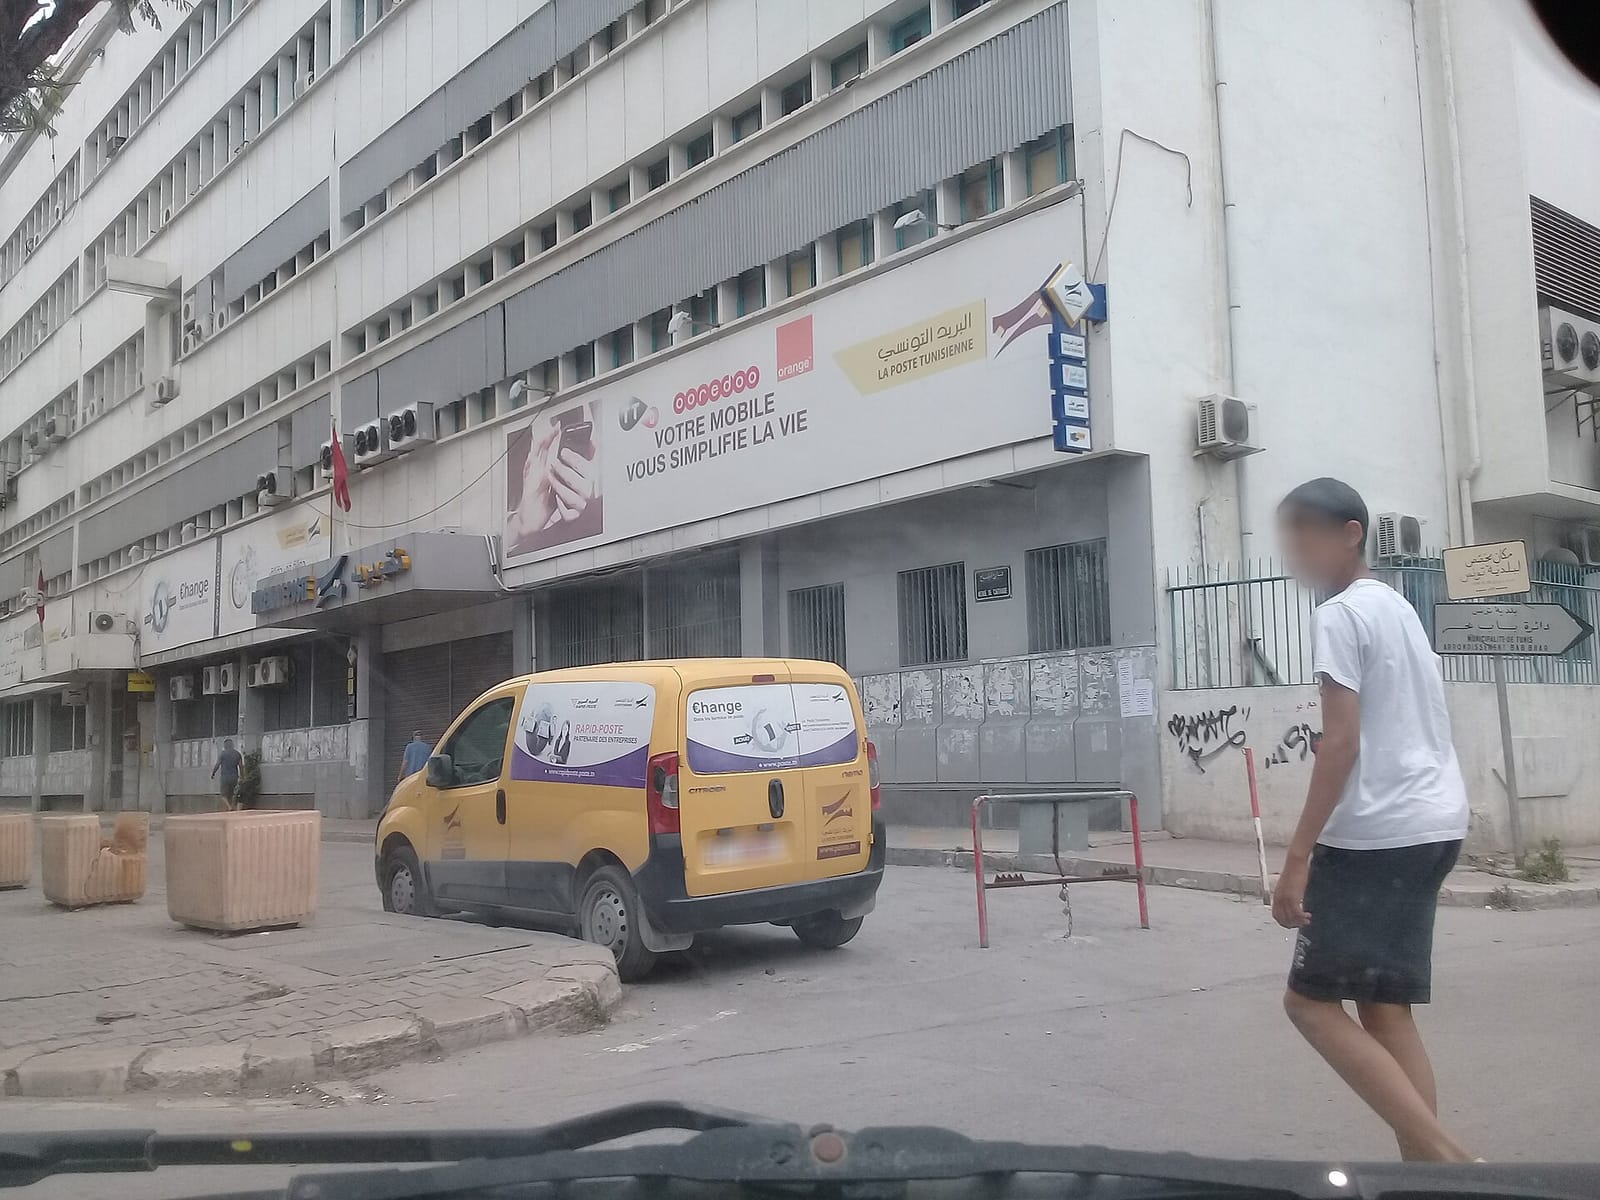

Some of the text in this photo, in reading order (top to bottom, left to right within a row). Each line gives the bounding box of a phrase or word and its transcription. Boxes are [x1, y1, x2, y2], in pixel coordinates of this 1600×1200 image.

[877, 311, 972, 362] البريد التونسي
[877, 338, 974, 381] LA POSTE TUNISIENNE
[674, 367, 759, 413] ooredoo
[778, 359, 810, 377] orange
[654, 392, 775, 449] VOTRE MOBILE
[626, 409, 808, 482] VOUS SIMPLIFIE LA VIE
